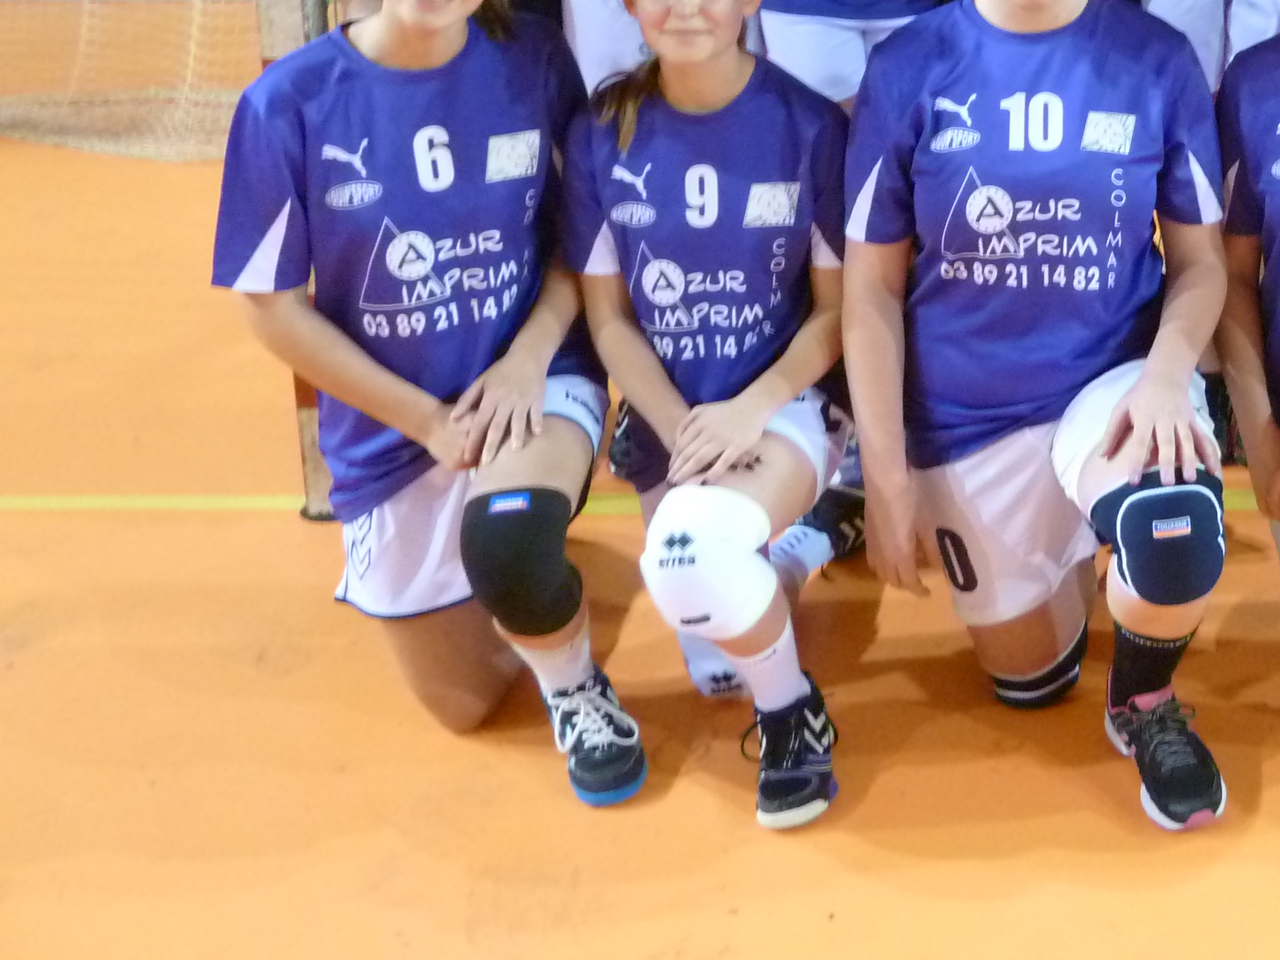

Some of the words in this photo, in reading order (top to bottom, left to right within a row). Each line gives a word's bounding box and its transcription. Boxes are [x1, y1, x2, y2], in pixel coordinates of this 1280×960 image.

[1000, 91, 1064, 152] 10
[412, 124, 455, 193] 6
[684, 163, 719, 229] 9
[978, 231, 1098, 258] IMPRIM
[1106, 168, 1126, 289] COLMAR
[401, 259, 518, 306] IMPRIM
[940, 261, 968, 280] 03
[972, 260, 998, 285] 89
[1005, 263, 1028, 289] 21
[1041, 263, 1067, 288] 14
[1072, 265, 1100, 291] 82
[362, 312, 390, 338] 03
[395, 311, 426, 338] 89
[433, 302, 459, 332] 21
[470, 295, 498, 323] 14
[654, 301, 764, 329] IMPRIM
[679, 333, 705, 361] 21
[714, 334, 738, 359] 14
